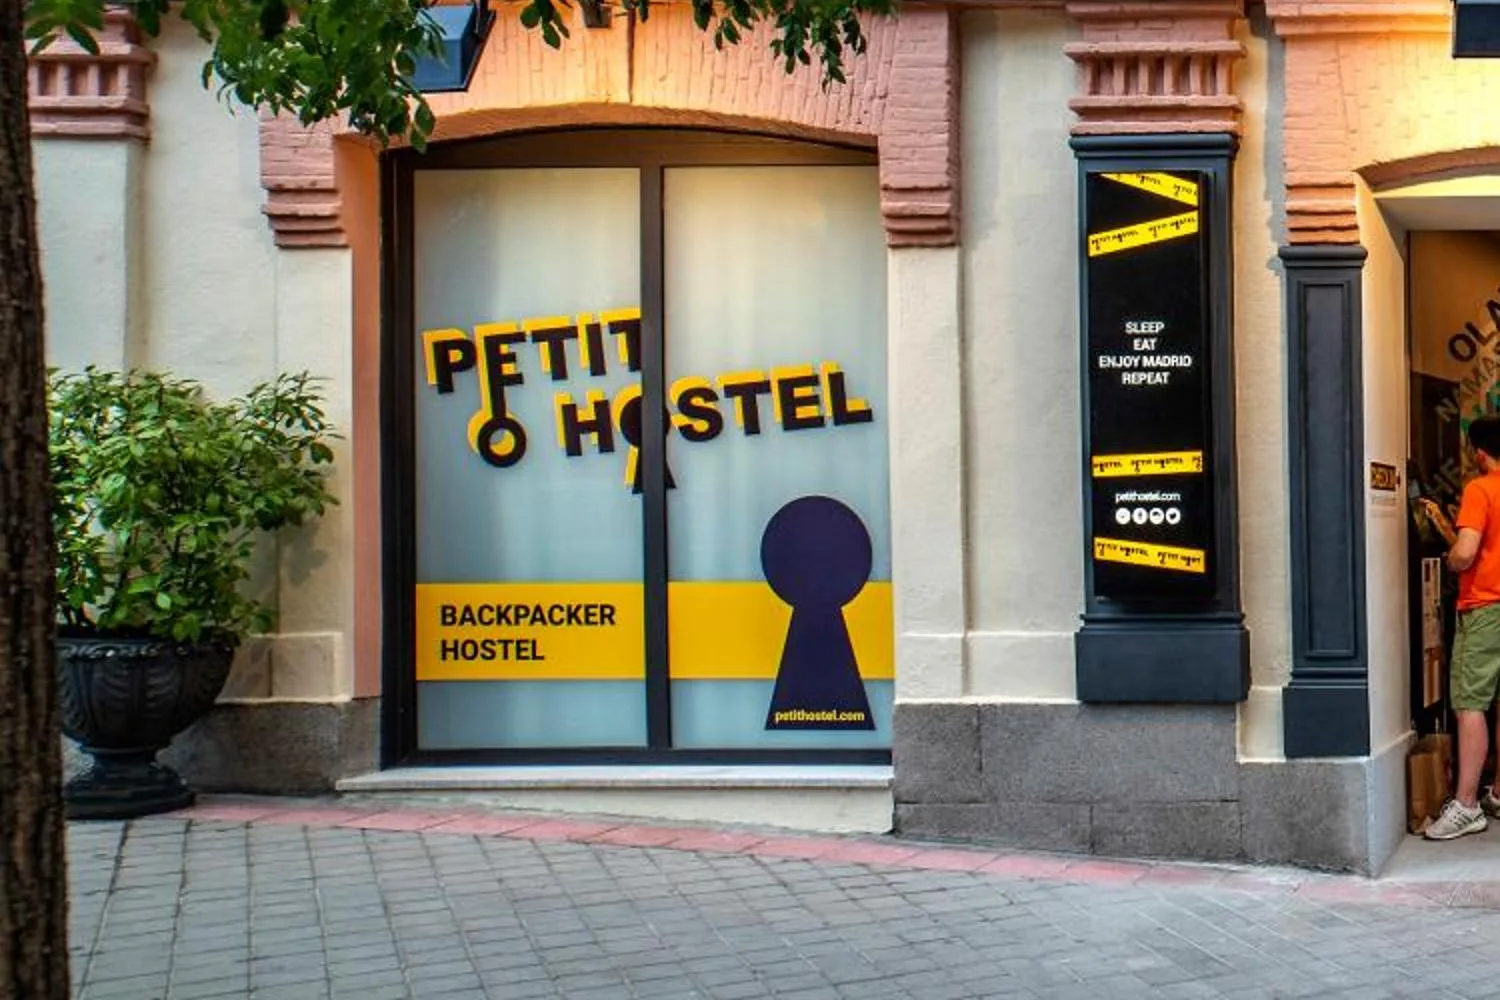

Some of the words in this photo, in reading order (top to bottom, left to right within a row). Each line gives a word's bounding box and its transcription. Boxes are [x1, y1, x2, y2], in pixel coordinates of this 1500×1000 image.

[1125, 322, 1165, 333] SLEEP
[1133, 338, 1156, 351] EAT
[1099, 356, 1140, 367] ENJOY
[1142, 356, 1192, 367] MADRID
[423, 305, 643, 467] PETIT
[1122, 372, 1170, 385] REPEAT
[555, 361, 873, 494] HOSTEL
[440, 604, 616, 627] BACKPACKER
[440, 638, 545, 662] HOSTEL
[774, 708, 866, 723] petithostel.com
